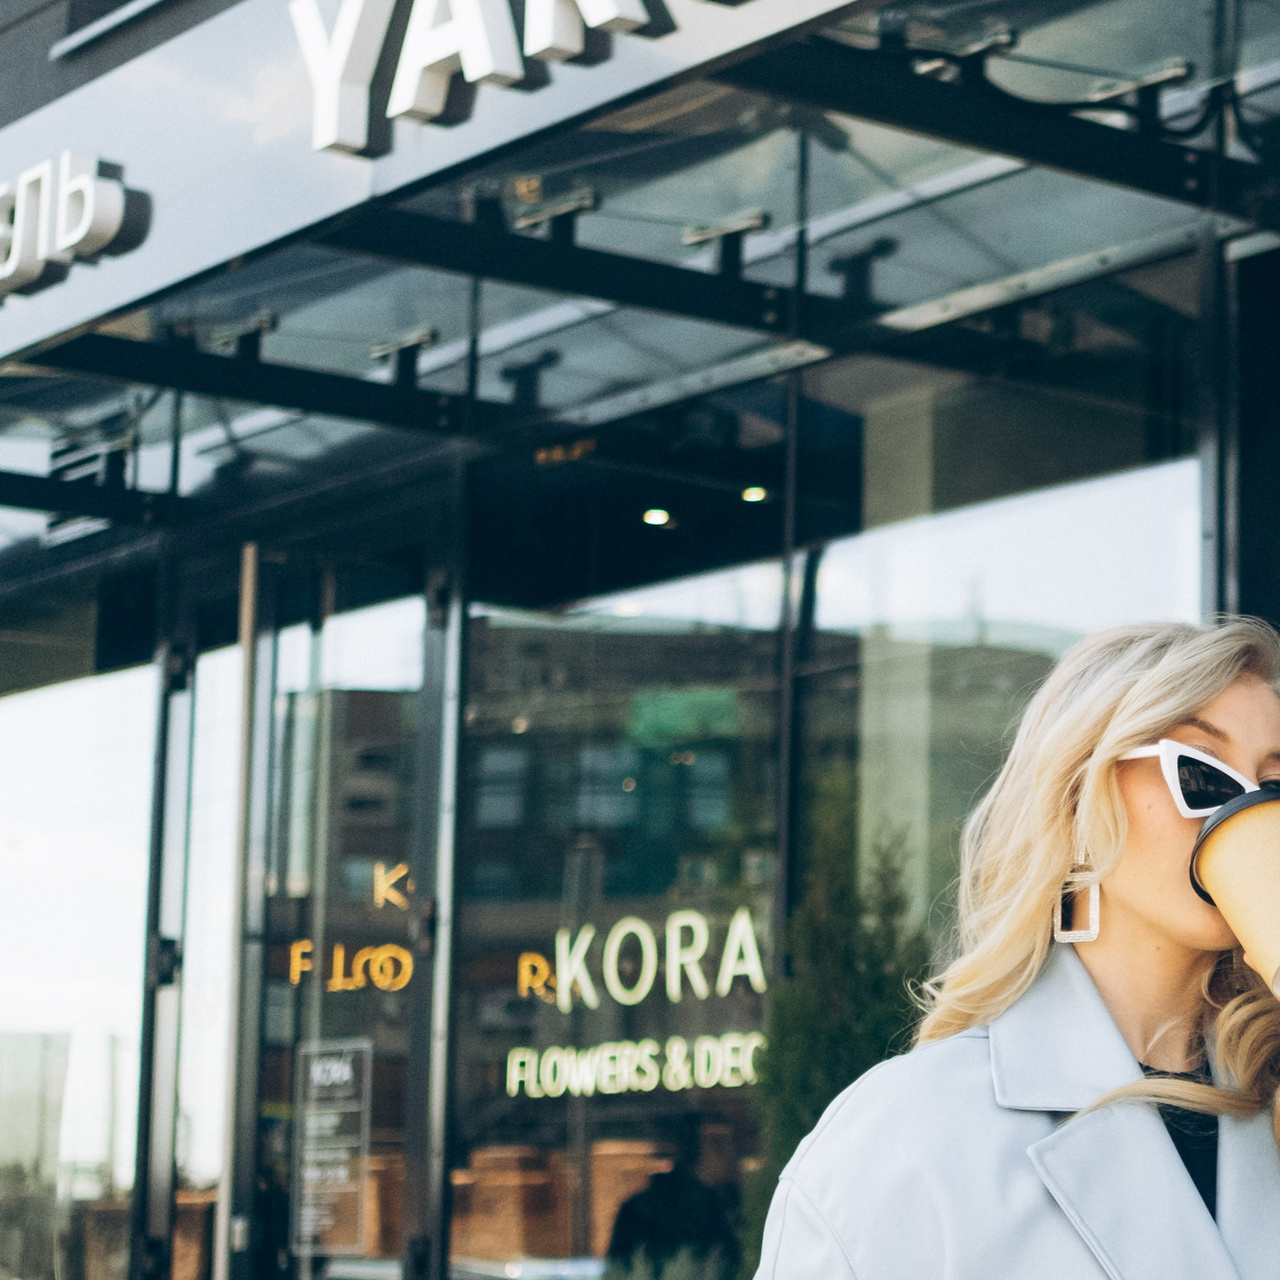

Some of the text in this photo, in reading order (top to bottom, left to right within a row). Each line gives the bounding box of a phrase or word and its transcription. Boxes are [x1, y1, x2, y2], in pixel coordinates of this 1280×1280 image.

[555, 905, 768, 1014] KORA
[506, 1038, 661, 1098] FLOWERS
[662, 1035, 694, 1092] &
